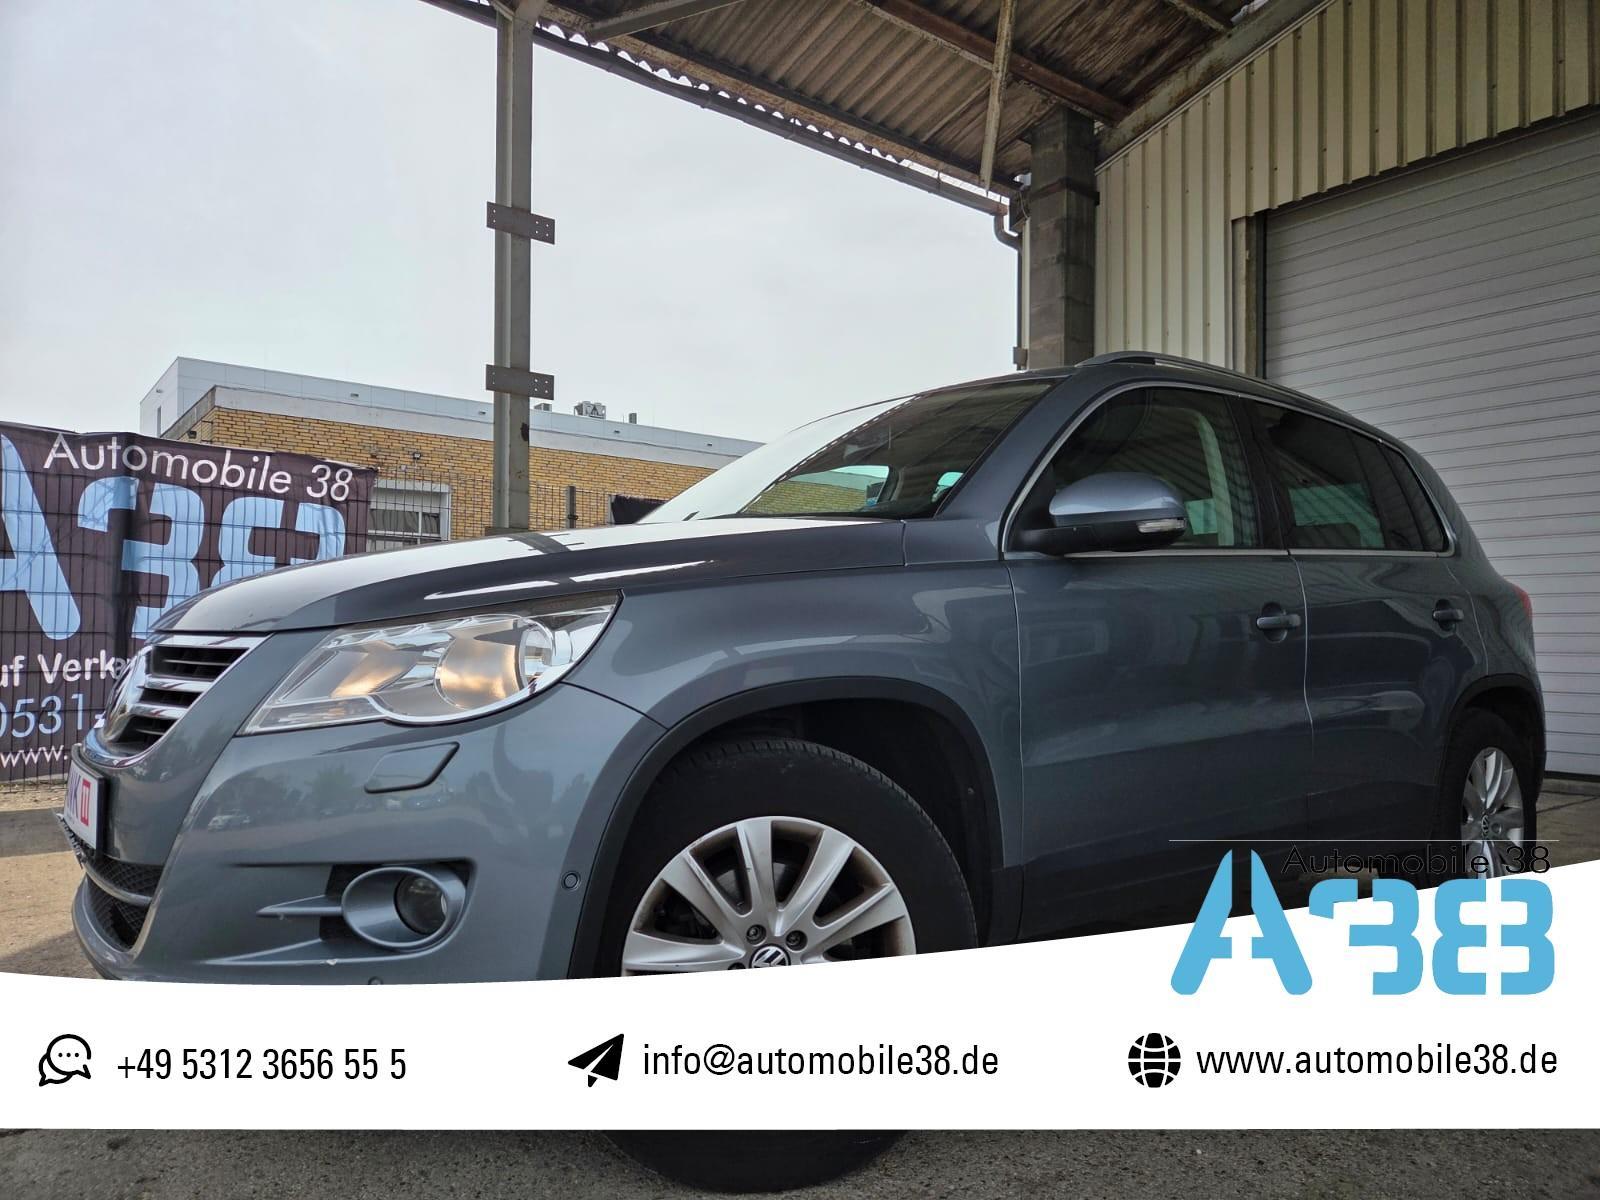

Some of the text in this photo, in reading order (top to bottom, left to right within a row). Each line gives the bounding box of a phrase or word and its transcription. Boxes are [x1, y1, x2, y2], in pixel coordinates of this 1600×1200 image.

[43, 433, 353, 502] Automobile 38
[37, 649, 130, 684] Verka
